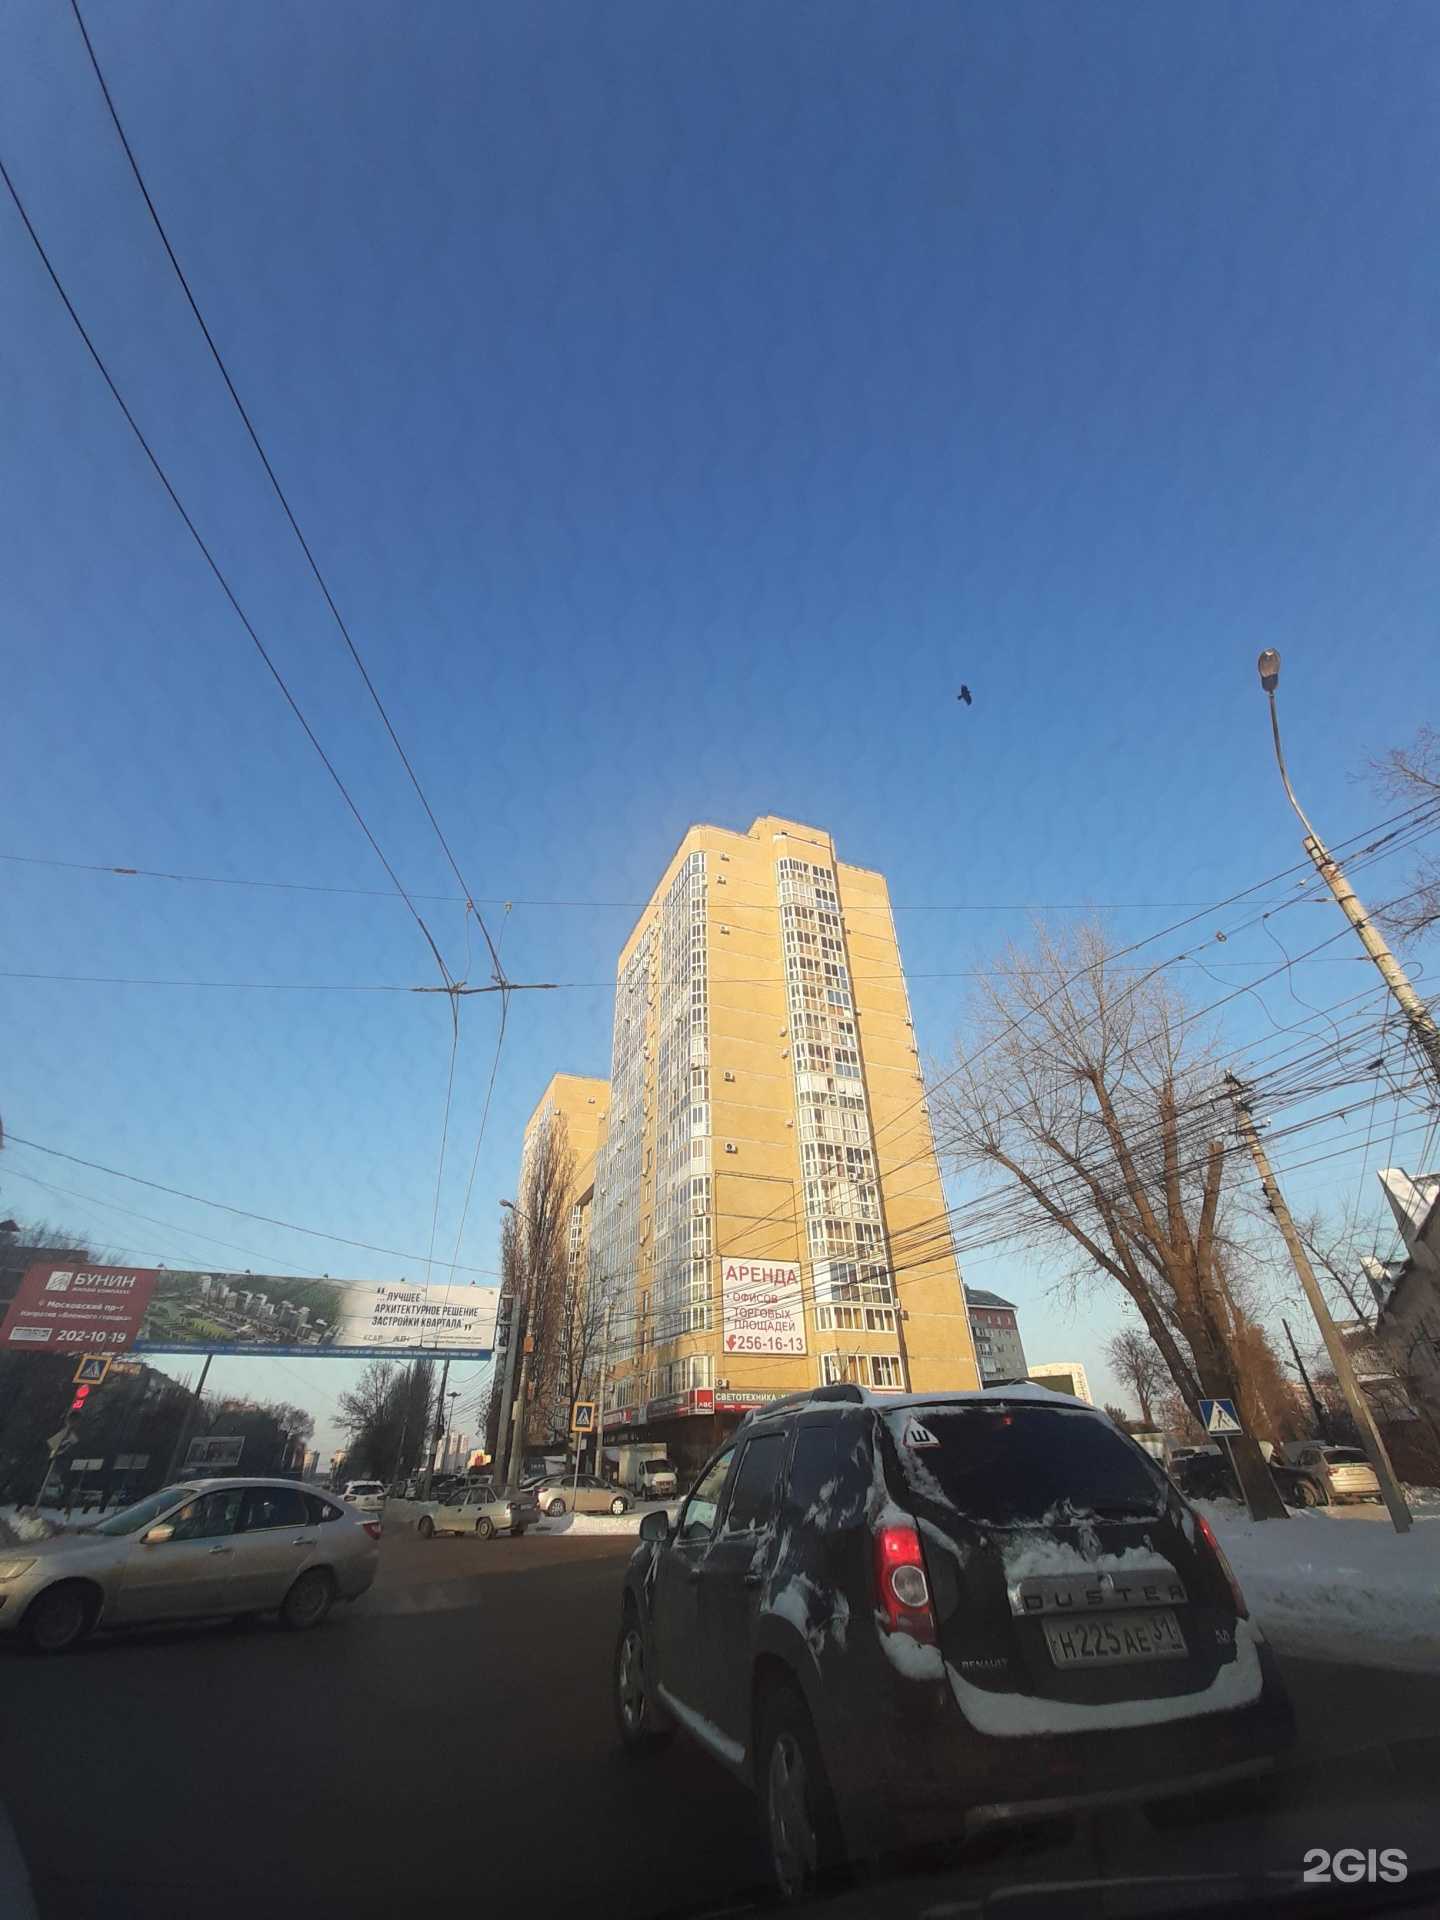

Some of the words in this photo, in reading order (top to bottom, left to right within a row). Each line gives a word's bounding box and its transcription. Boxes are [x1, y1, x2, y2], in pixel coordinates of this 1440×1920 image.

[74, 1273, 137, 1287] БУНИН
[726, 1265, 798, 1286] АРЕНДА
[733, 1292, 779, 1304] ОФИСОВ
[374, 1304, 441, 1316] АРХИТЕКТУРНОЕ
[442, 1306, 480, 1318] РЕШЕНИЕ
[734, 1307, 791, 1319] ТОРГОВЫХ
[371, 1315, 419, 1327] ЗАСТРОЙКИ
[734, 1318, 796, 1332] ПЛОЩАДЕЙ
[56, 1330, 126, 1343] 202-10-19
[737, 1336, 804, 1351] 256-16-13
[715, 1392, 777, 1402] СВЕТОТЕХНИКА
[1023, 1585, 1186, 1611] DUSTER
